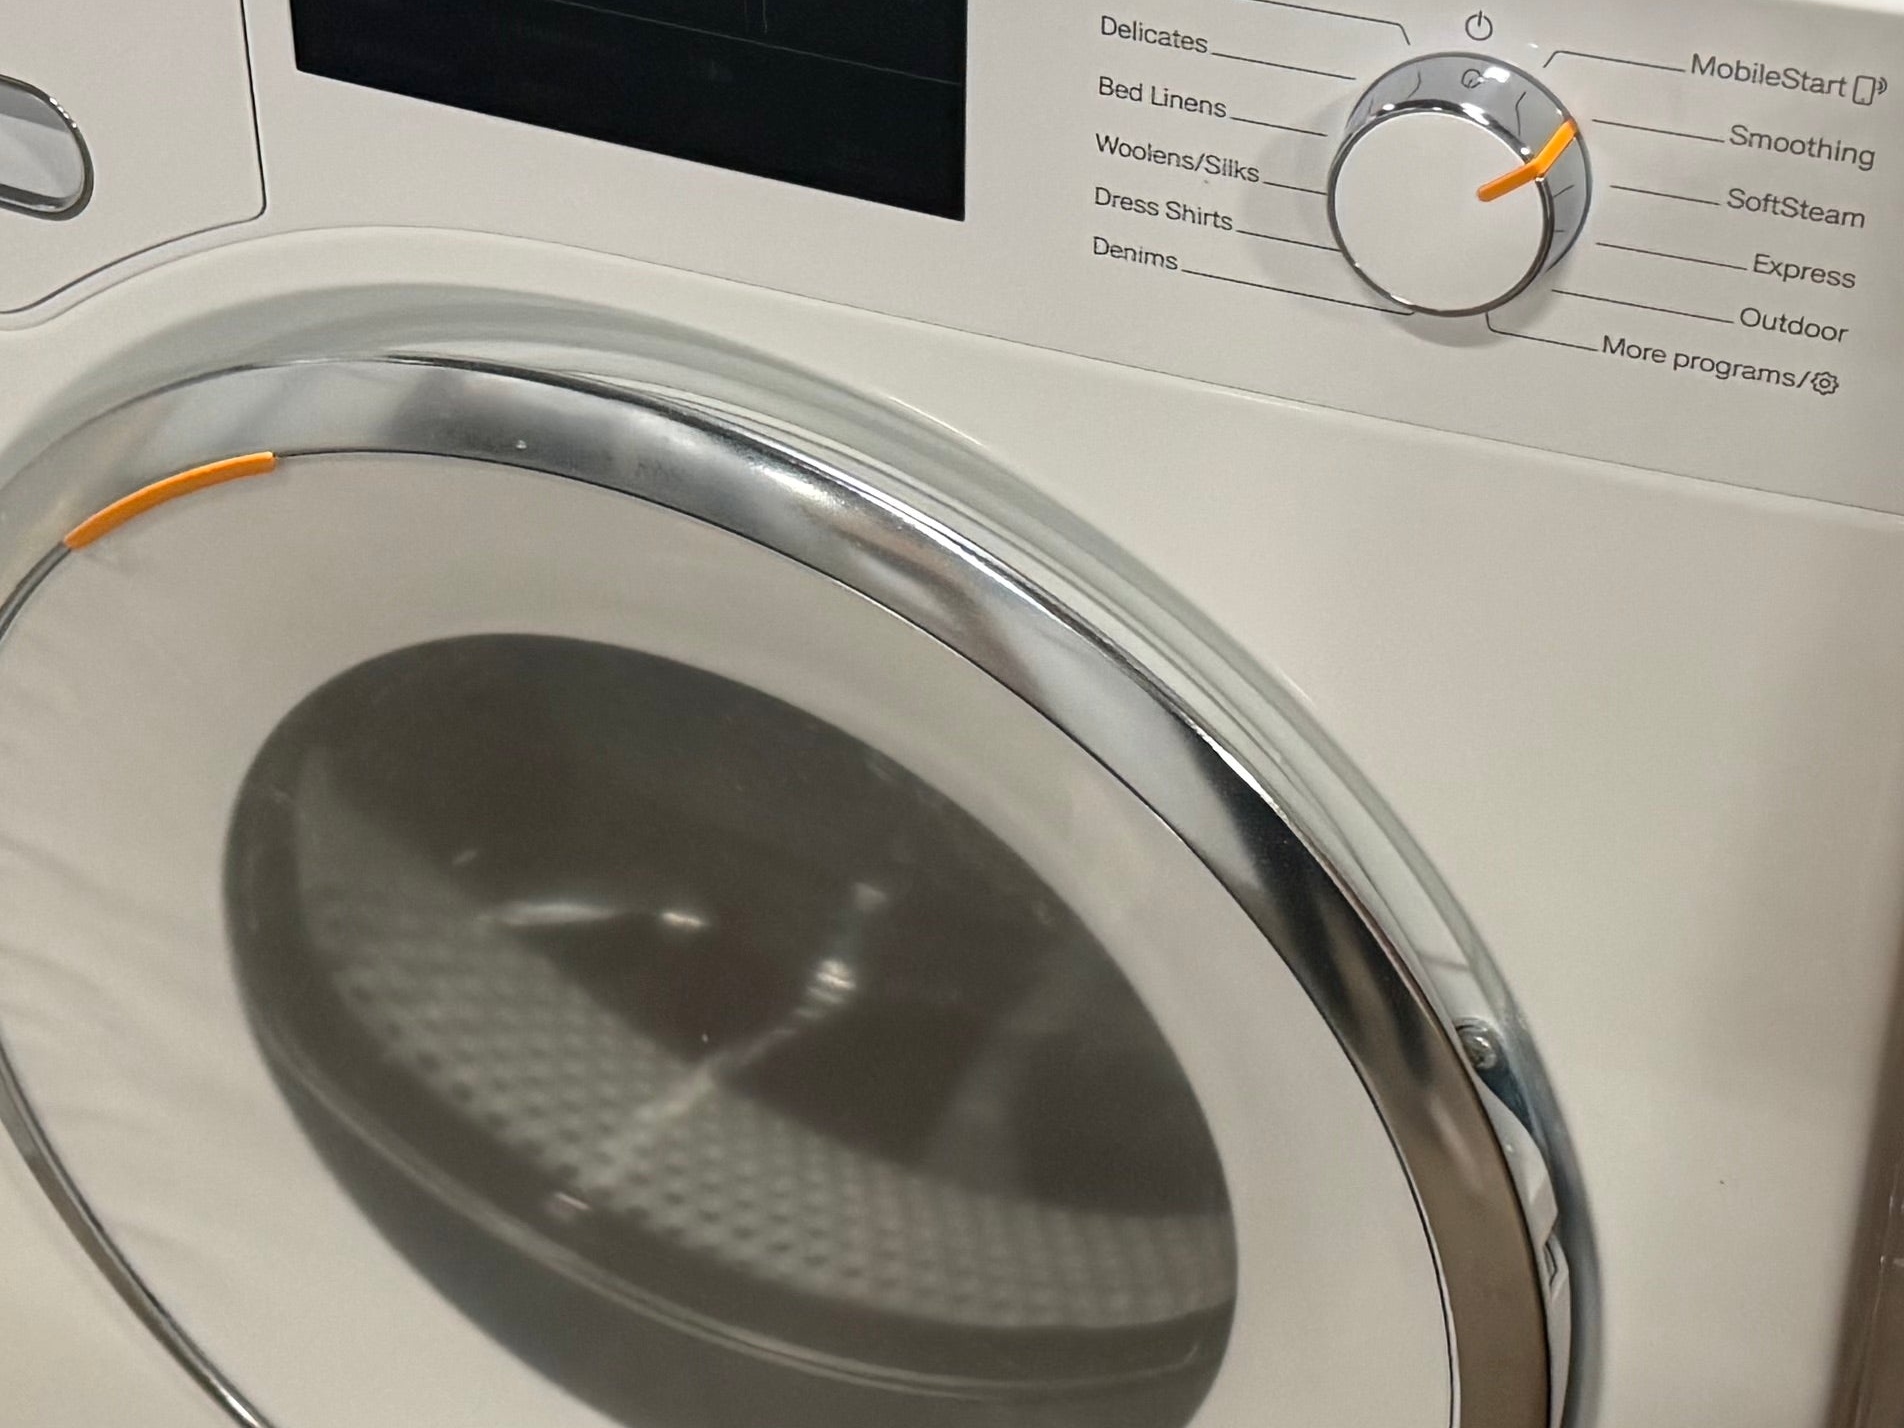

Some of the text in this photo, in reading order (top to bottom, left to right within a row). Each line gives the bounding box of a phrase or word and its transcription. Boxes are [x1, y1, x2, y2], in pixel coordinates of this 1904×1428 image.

[1100, 15, 1208, 54] Delicates
[1690, 53, 1848, 98] MobileStart
[1098, 76, 1227, 118] Bed Linens
[1095, 133, 1260, 183] Woolens/Silks
[1729, 124, 1876, 171] Smoothing
[1094, 187, 1234, 232] Dress Shirts
[1726, 188, 1866, 229] SoftSteam
[1093, 237, 1178, 271] Denims
[1752, 254, 1857, 289] Express
[1739, 308, 1849, 343] Outdoor
[1602, 335, 1667, 363] More
